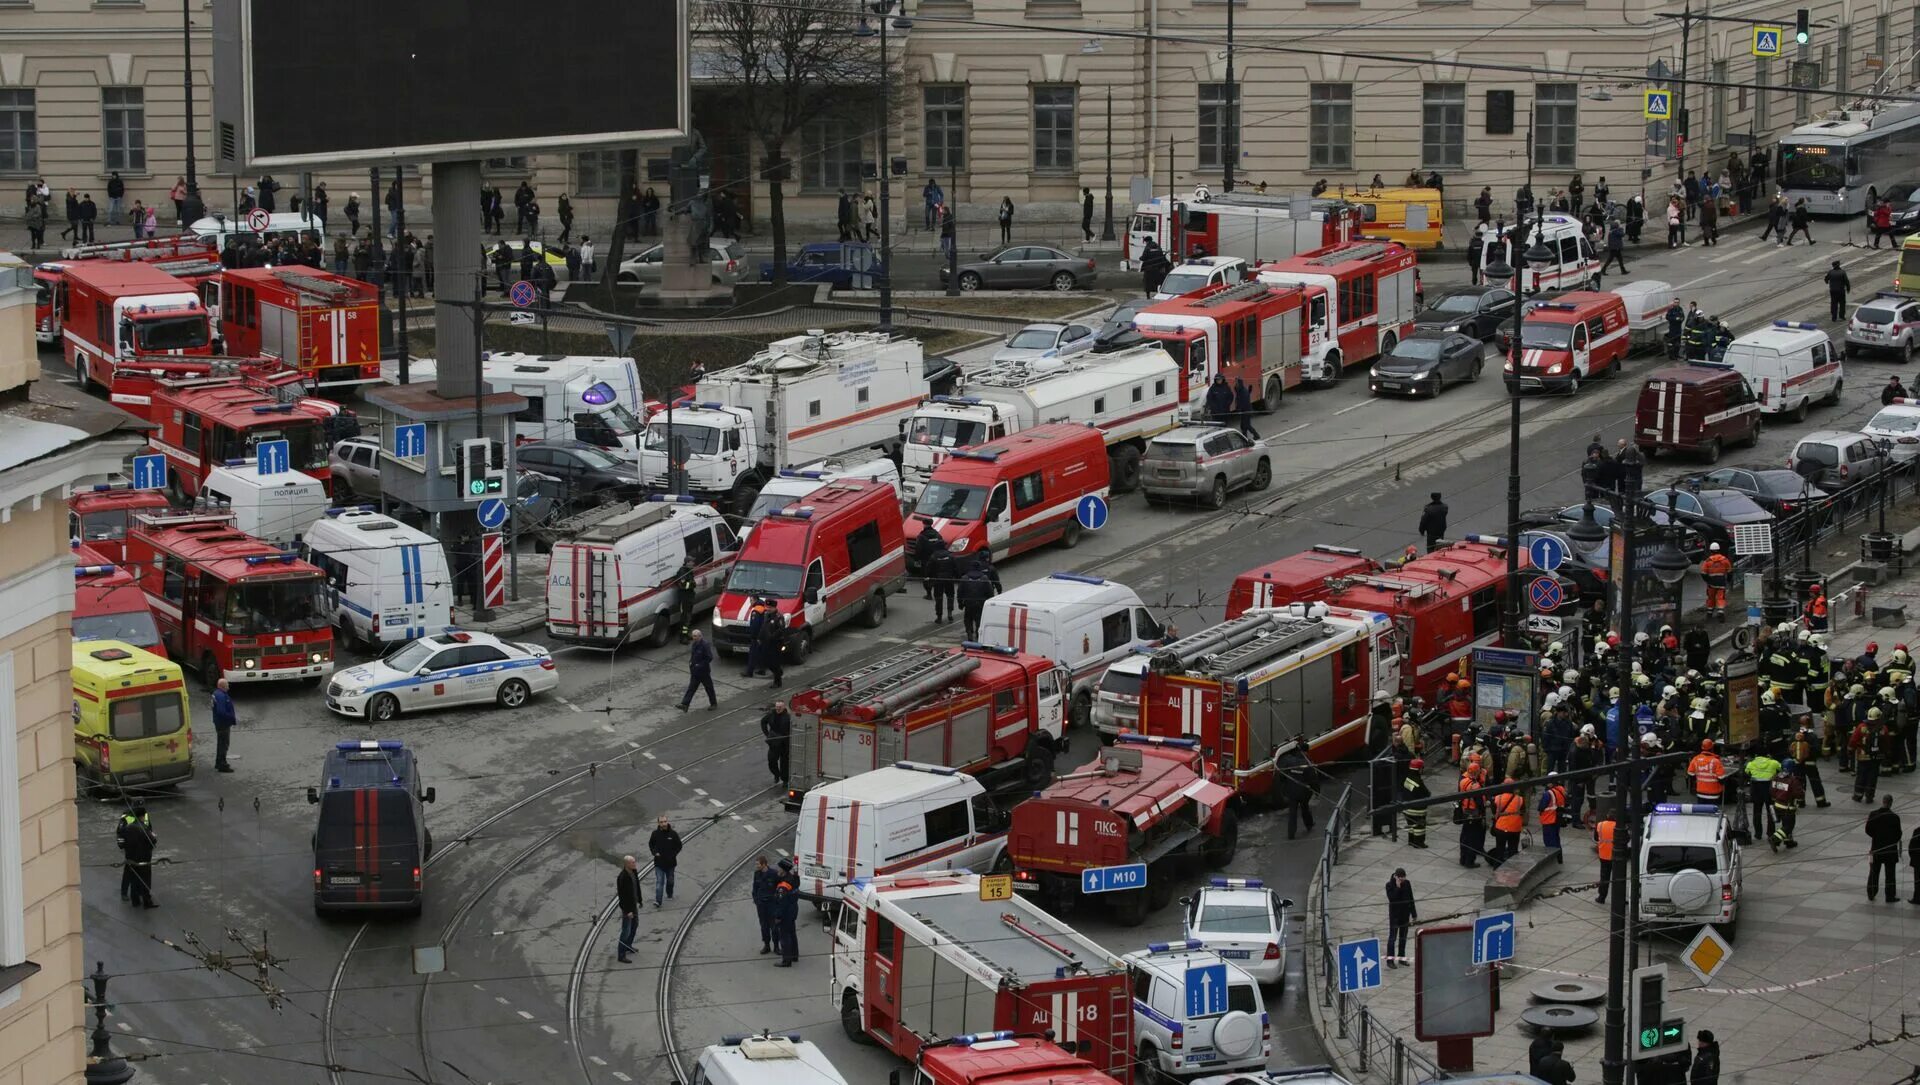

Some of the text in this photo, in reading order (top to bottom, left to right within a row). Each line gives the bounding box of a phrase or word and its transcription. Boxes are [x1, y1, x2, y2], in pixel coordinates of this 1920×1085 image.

[319, 311, 357, 322] АГ 58
[1311, 333, 1320, 344] 23
[274, 487, 308, 497] ПОЛИЦИЯ
[552, 575, 571, 587] АСА
[420, 672, 448, 682] ПОЛИЦИЯ
[1168, 696, 1213, 713] АЦ 9
[1050, 708, 1058, 721] 38
[823, 727, 872, 746] АЦ 38
[1094, 820, 1117, 833] ПКС
[990, 888, 1002, 898] 15
[1032, 1004, 1098, 1025] АЦ 18
